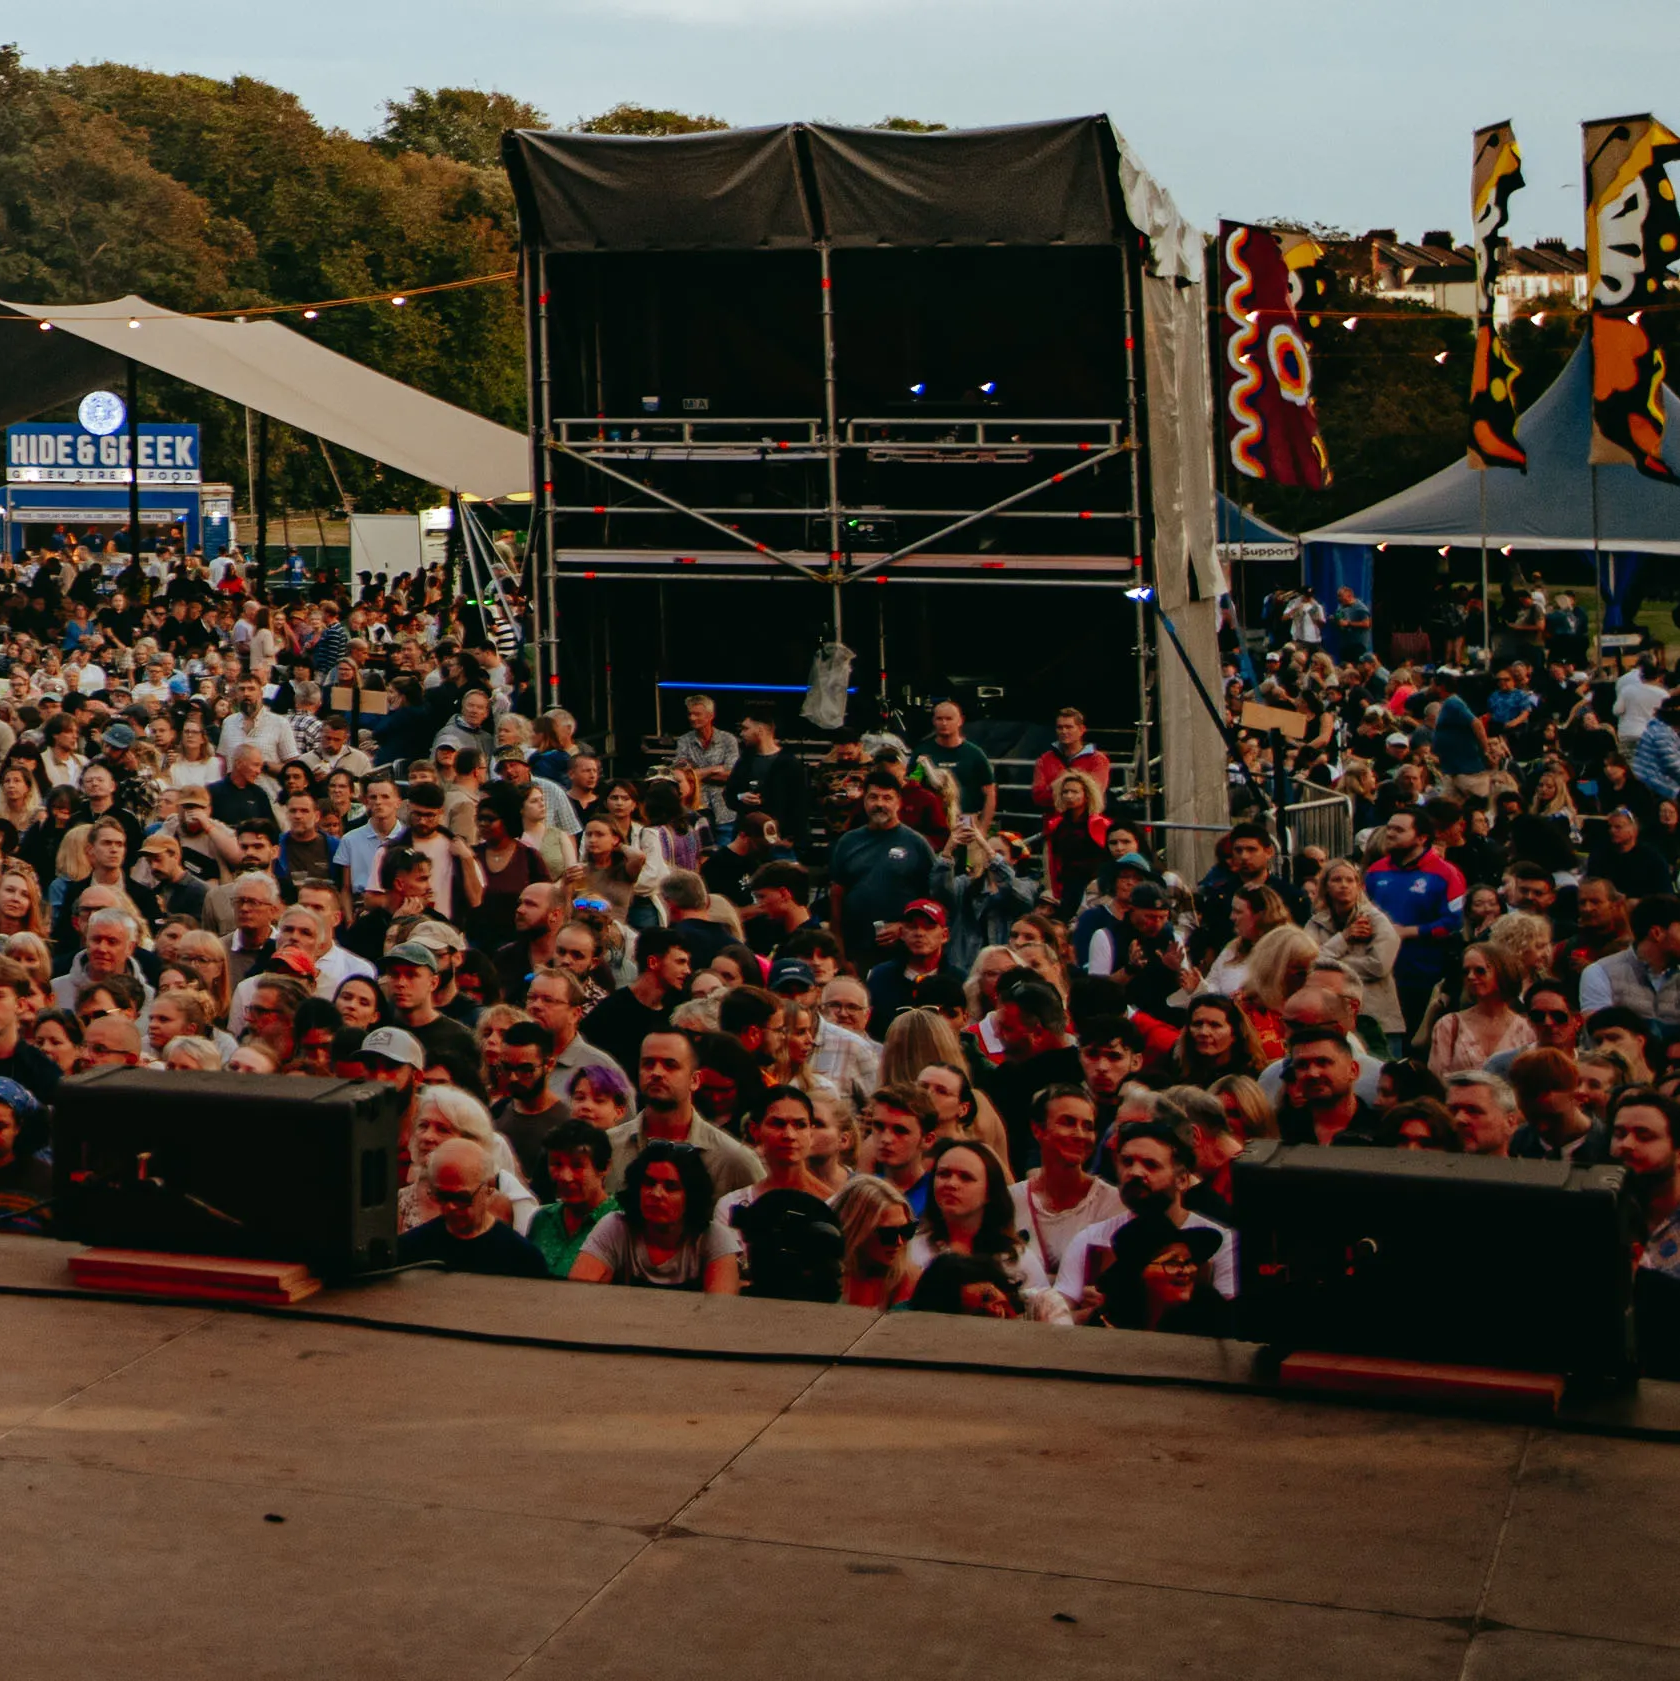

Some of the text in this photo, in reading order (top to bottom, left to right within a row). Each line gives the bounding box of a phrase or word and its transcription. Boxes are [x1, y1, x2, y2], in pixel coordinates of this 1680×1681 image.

[10, 434, 74, 466] HIDE
[76, 434, 96, 466] &
[12, 470, 194, 481] GEEK STREE FOOD
[1241, 547, 1294, 557] Support
